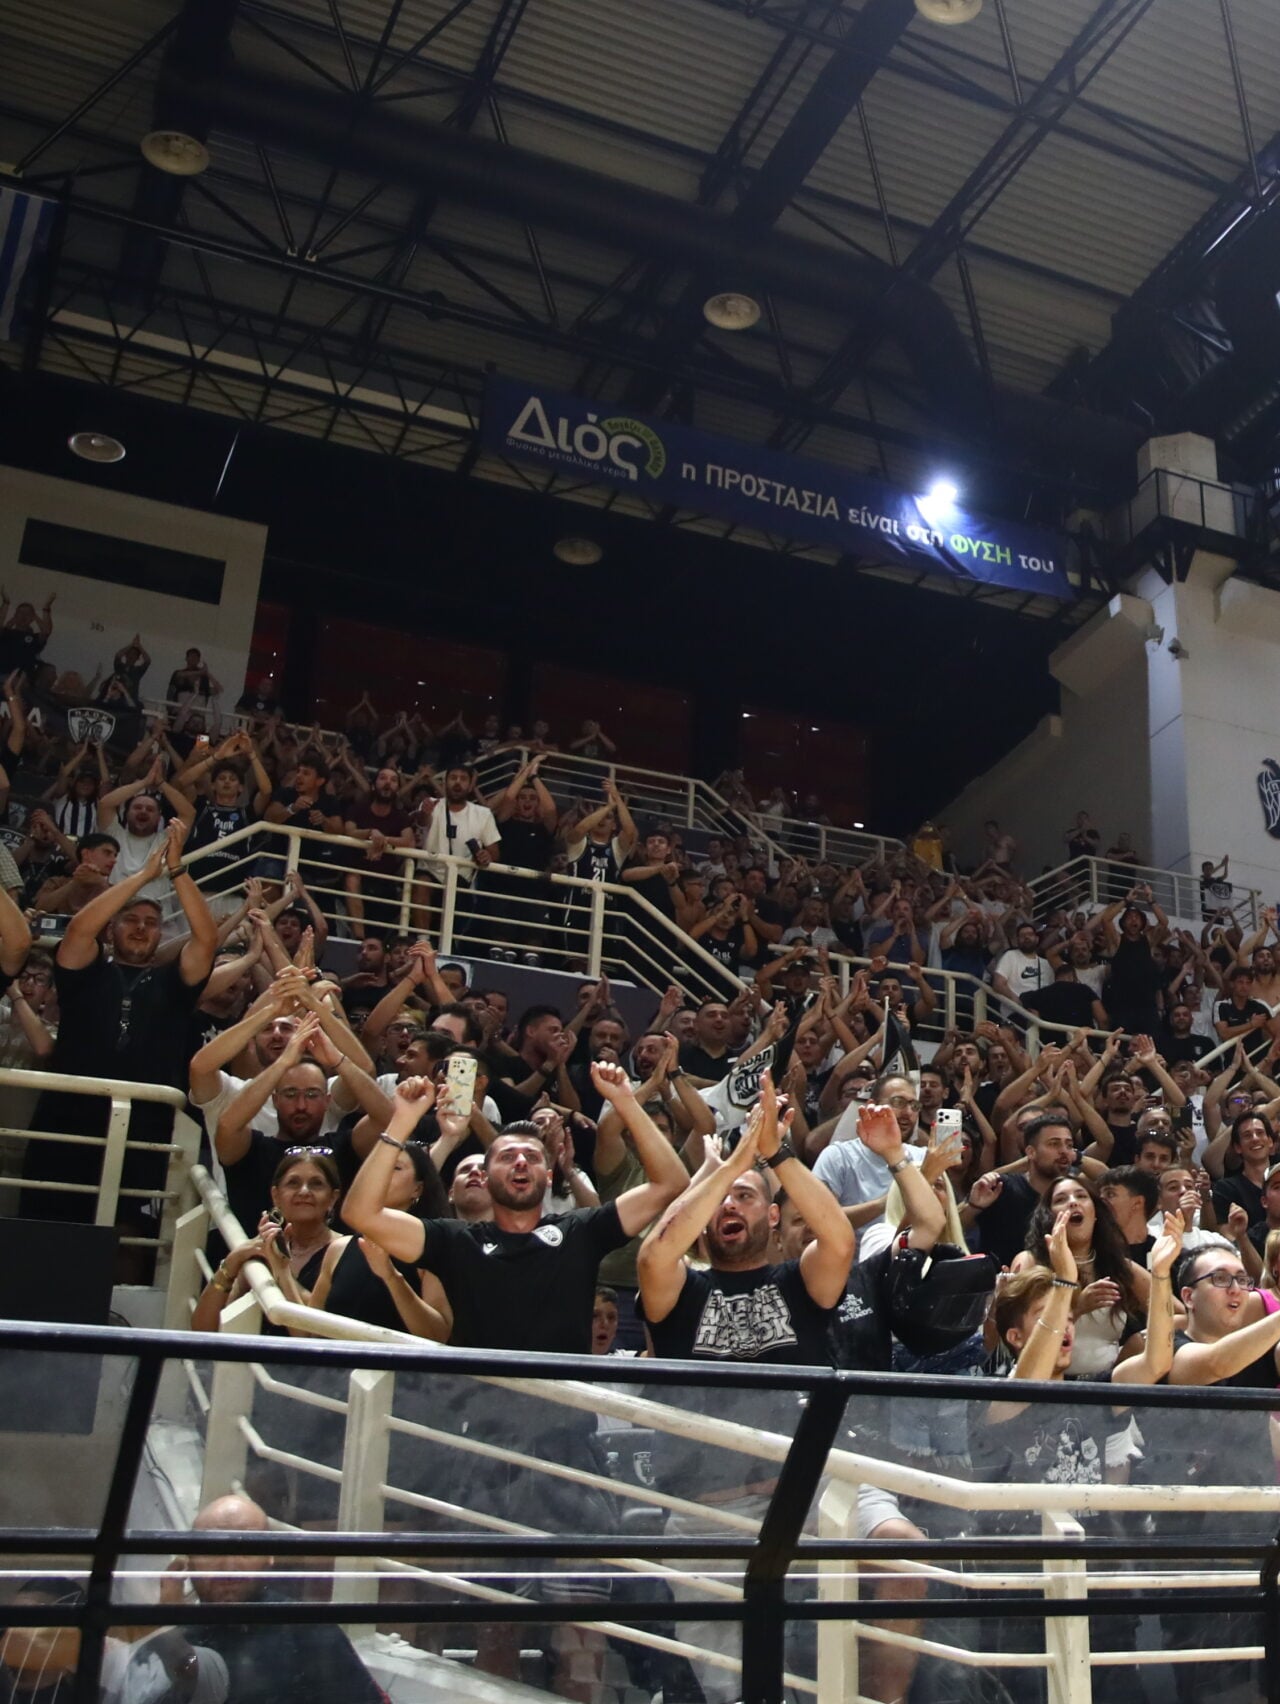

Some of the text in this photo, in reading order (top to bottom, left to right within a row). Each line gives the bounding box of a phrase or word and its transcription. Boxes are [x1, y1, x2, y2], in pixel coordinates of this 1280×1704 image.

[681, 461, 697, 481] η
[705, 463, 840, 521] ΠΡΟΣΤΑΣΙΑ
[847, 506, 899, 536] είναι
[949, 534, 1012, 566] ΦΥΣΗ
[1017, 554, 1055, 574] του
